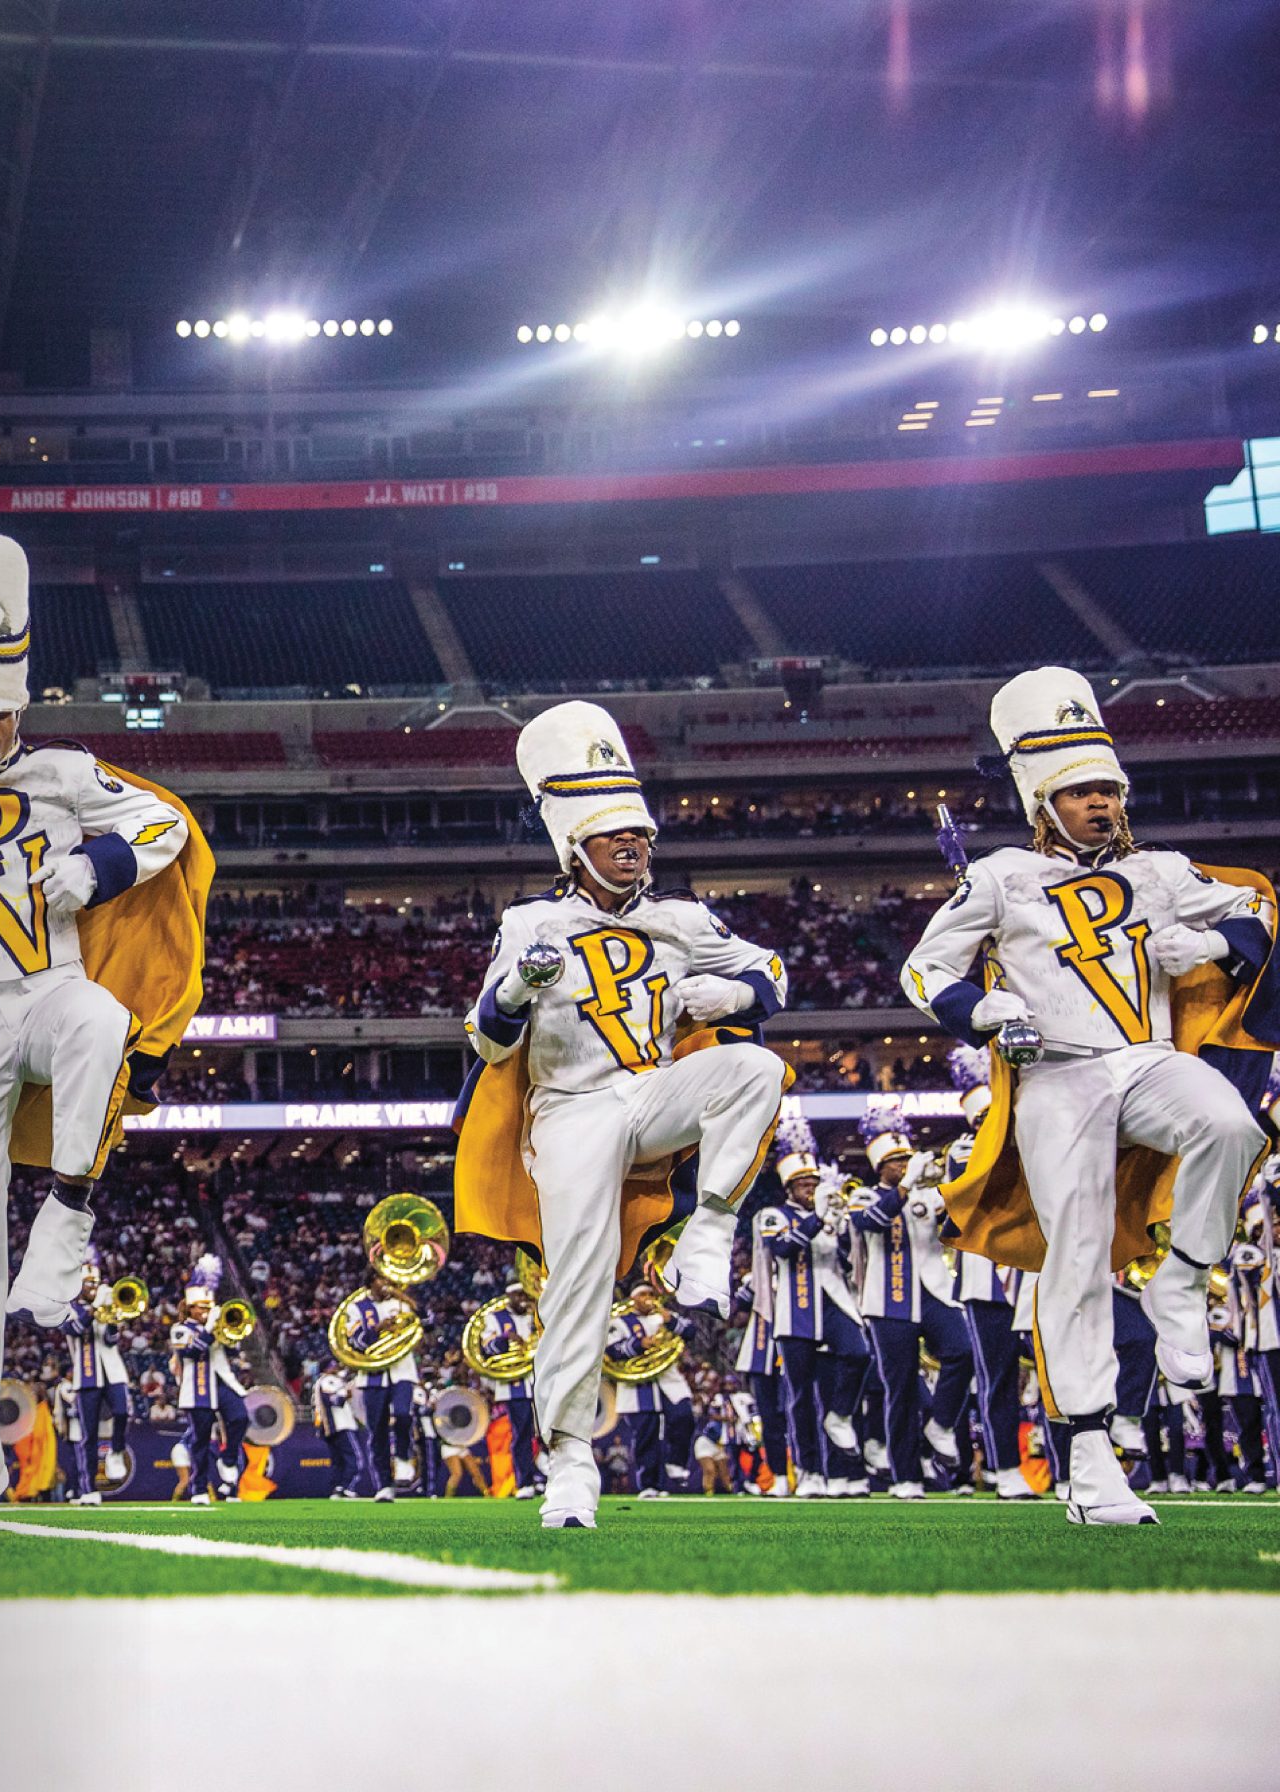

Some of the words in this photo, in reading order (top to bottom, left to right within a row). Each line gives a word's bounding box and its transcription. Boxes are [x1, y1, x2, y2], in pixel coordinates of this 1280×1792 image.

[11, 490, 67, 509] ANDRE
[71, 490, 150, 509] JOHNSON
[168, 489, 202, 508] #80
[365, 485, 397, 505] J.J.
[401, 484, 446, 504] WATT
[464, 482, 498, 501] #99
[285, 1103, 381, 1127] PRAIRIE
[385, 1103, 449, 1126] VIEW
[890, 1214, 905, 1304] ANTHERS
